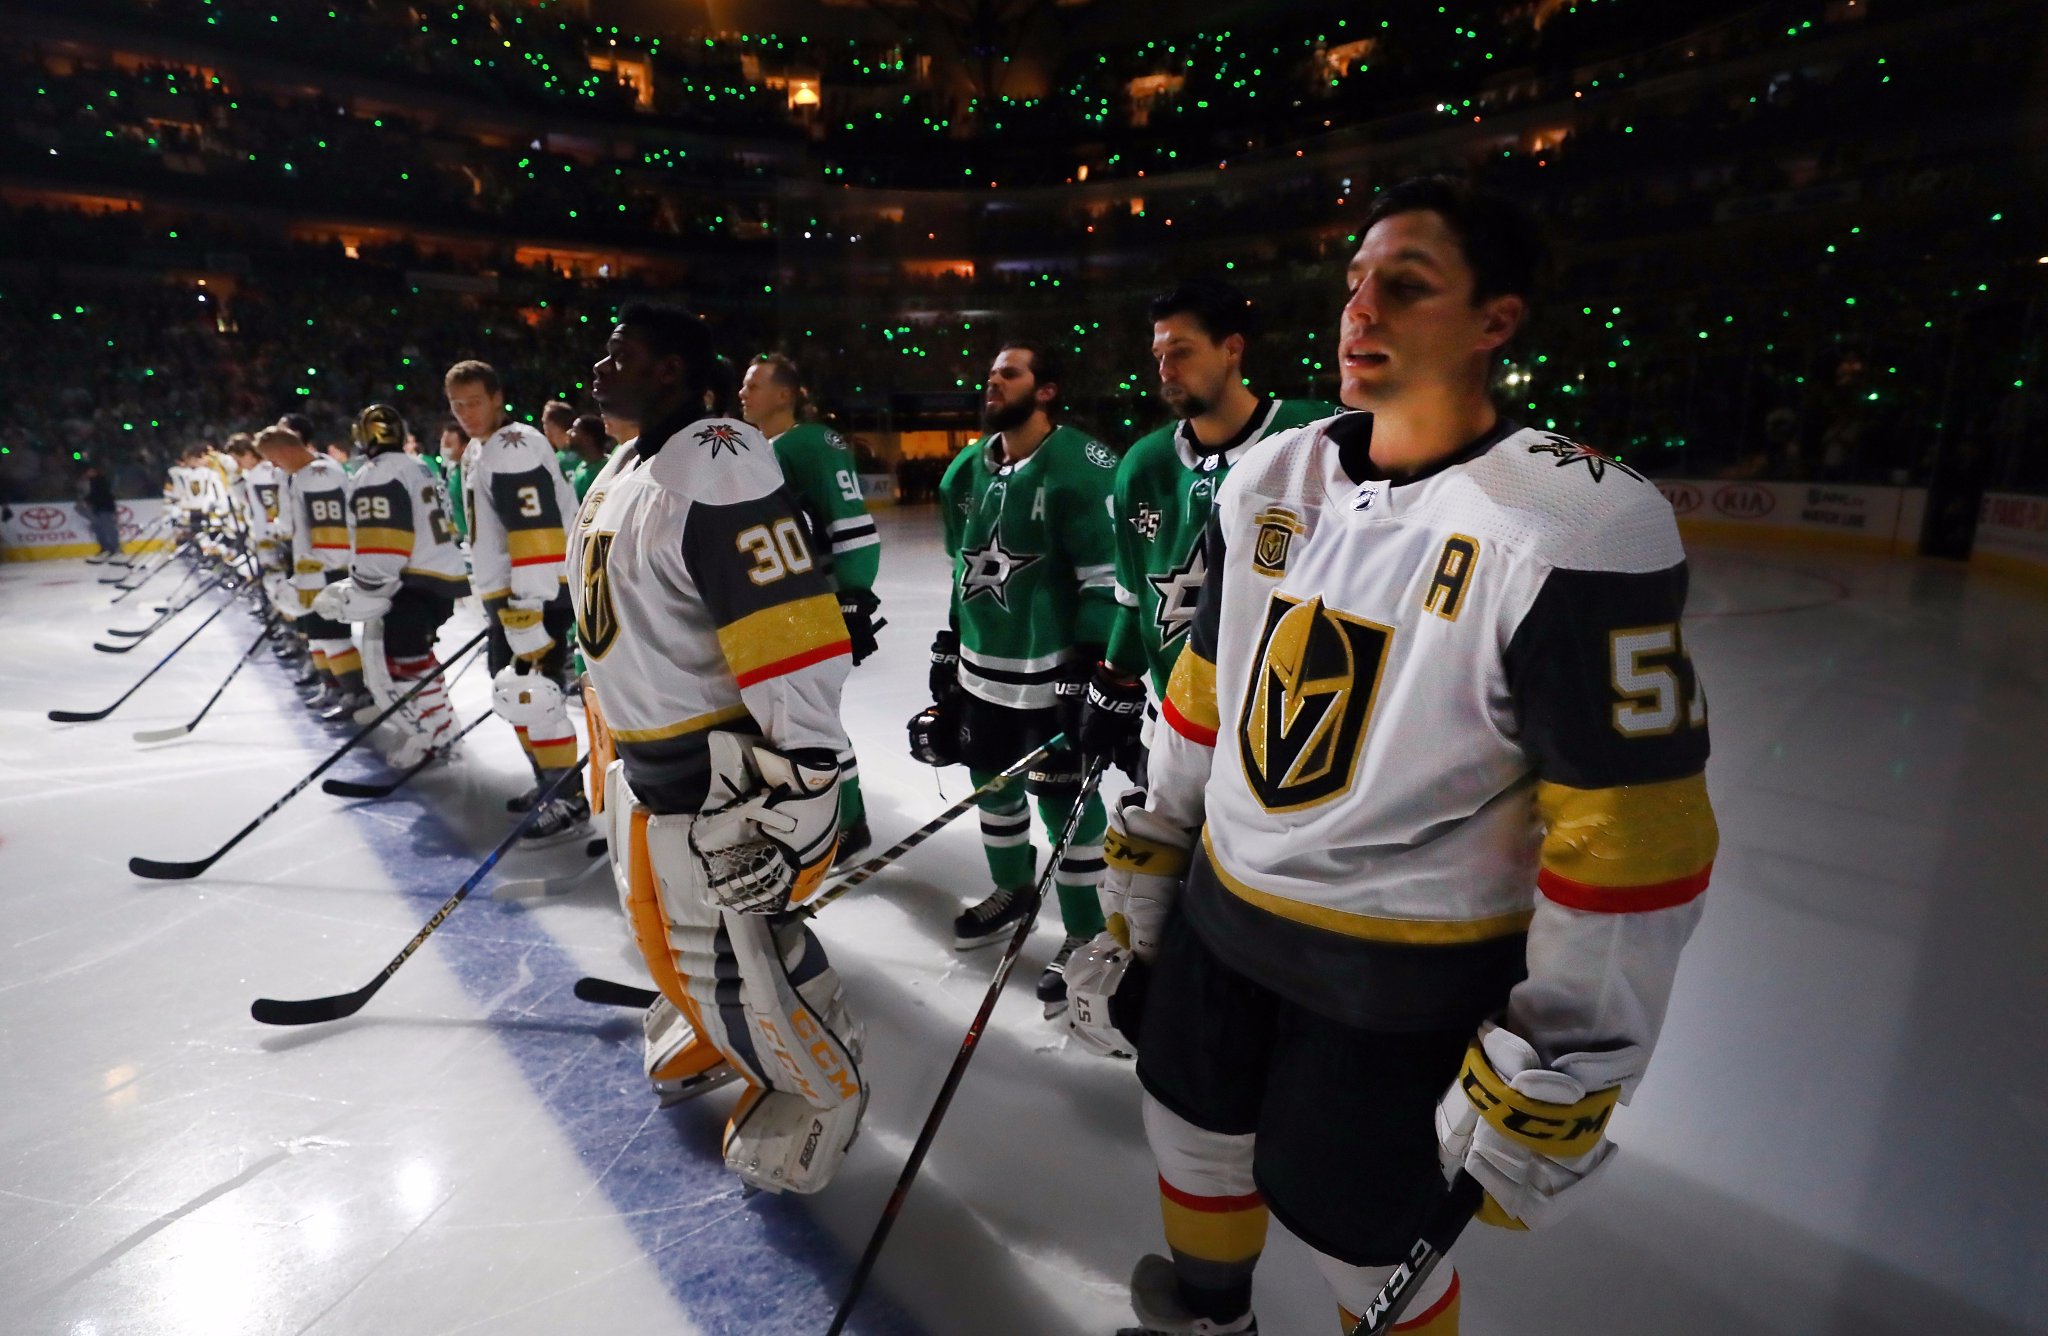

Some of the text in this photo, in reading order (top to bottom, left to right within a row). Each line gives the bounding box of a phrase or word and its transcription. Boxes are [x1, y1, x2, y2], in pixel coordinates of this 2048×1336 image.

[311, 500, 342, 521] 88
[355, 496, 391, 520] 29
[516, 485, 543, 518] 3
[1030, 486, 1047, 521] A
[1722, 491, 1764, 512] KIA
[17, 531, 77, 543] TOYOTA
[1138, 508, 1160, 538] 25
[736, 517, 813, 586] 30
[1423, 532, 1481, 622] A
[1076, 996, 1092, 1024] 57
[758, 1018, 818, 1098] CCM
[790, 1007, 859, 1099] CCM
[1462, 1066, 1612, 1141] CCM
[1363, 1237, 1433, 1330] CCM
